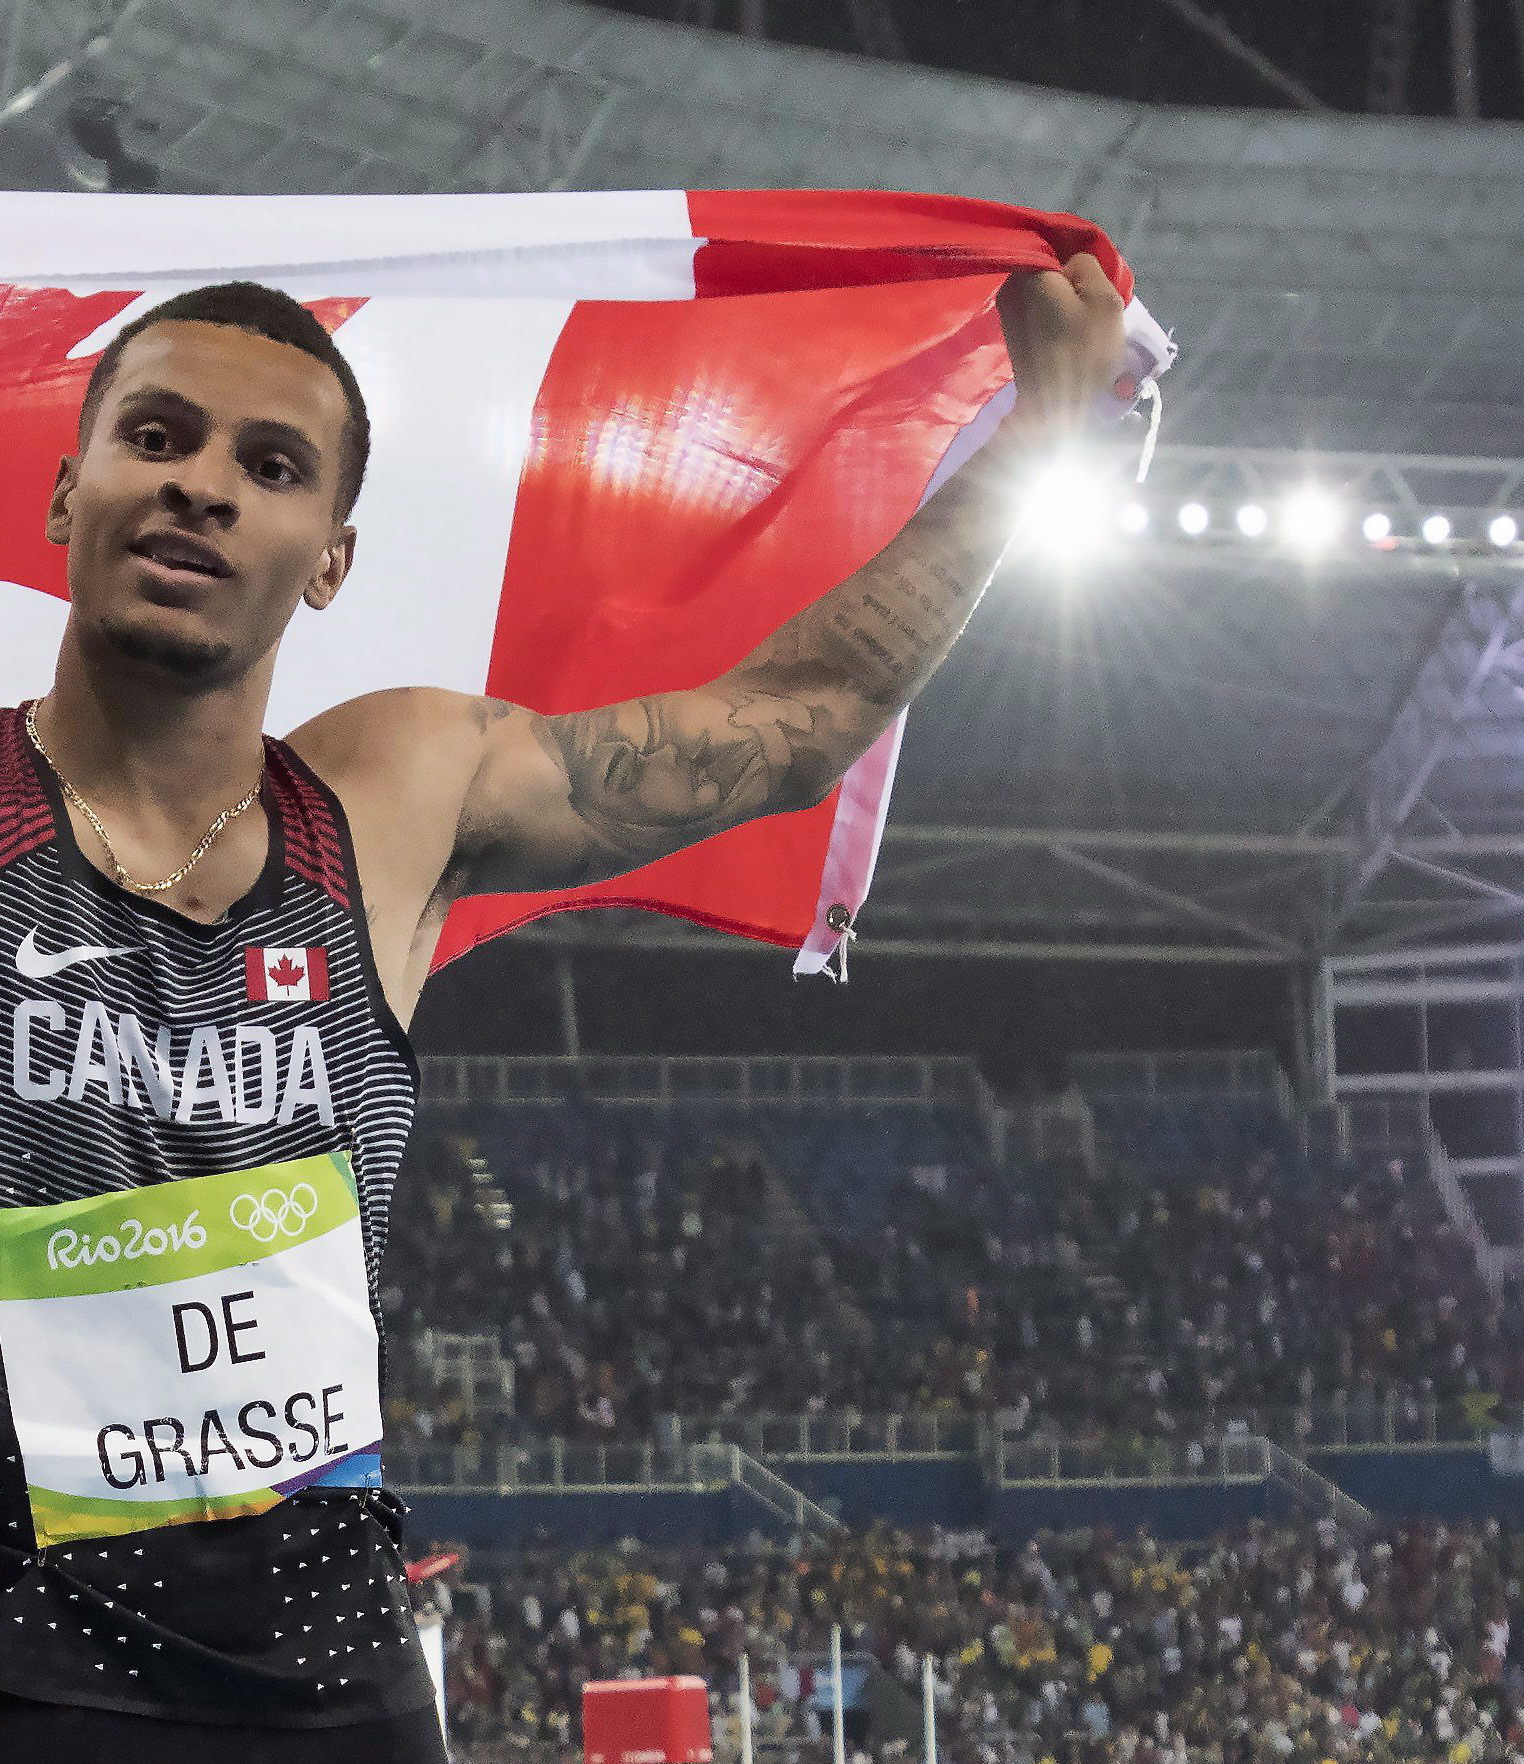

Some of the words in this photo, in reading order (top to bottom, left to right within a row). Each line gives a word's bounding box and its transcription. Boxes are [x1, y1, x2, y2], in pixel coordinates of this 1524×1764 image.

[13, 999, 335, 1127] CANADA
[172, 1290, 266, 1373] DE
[96, 1384, 348, 1489] GRASSE
